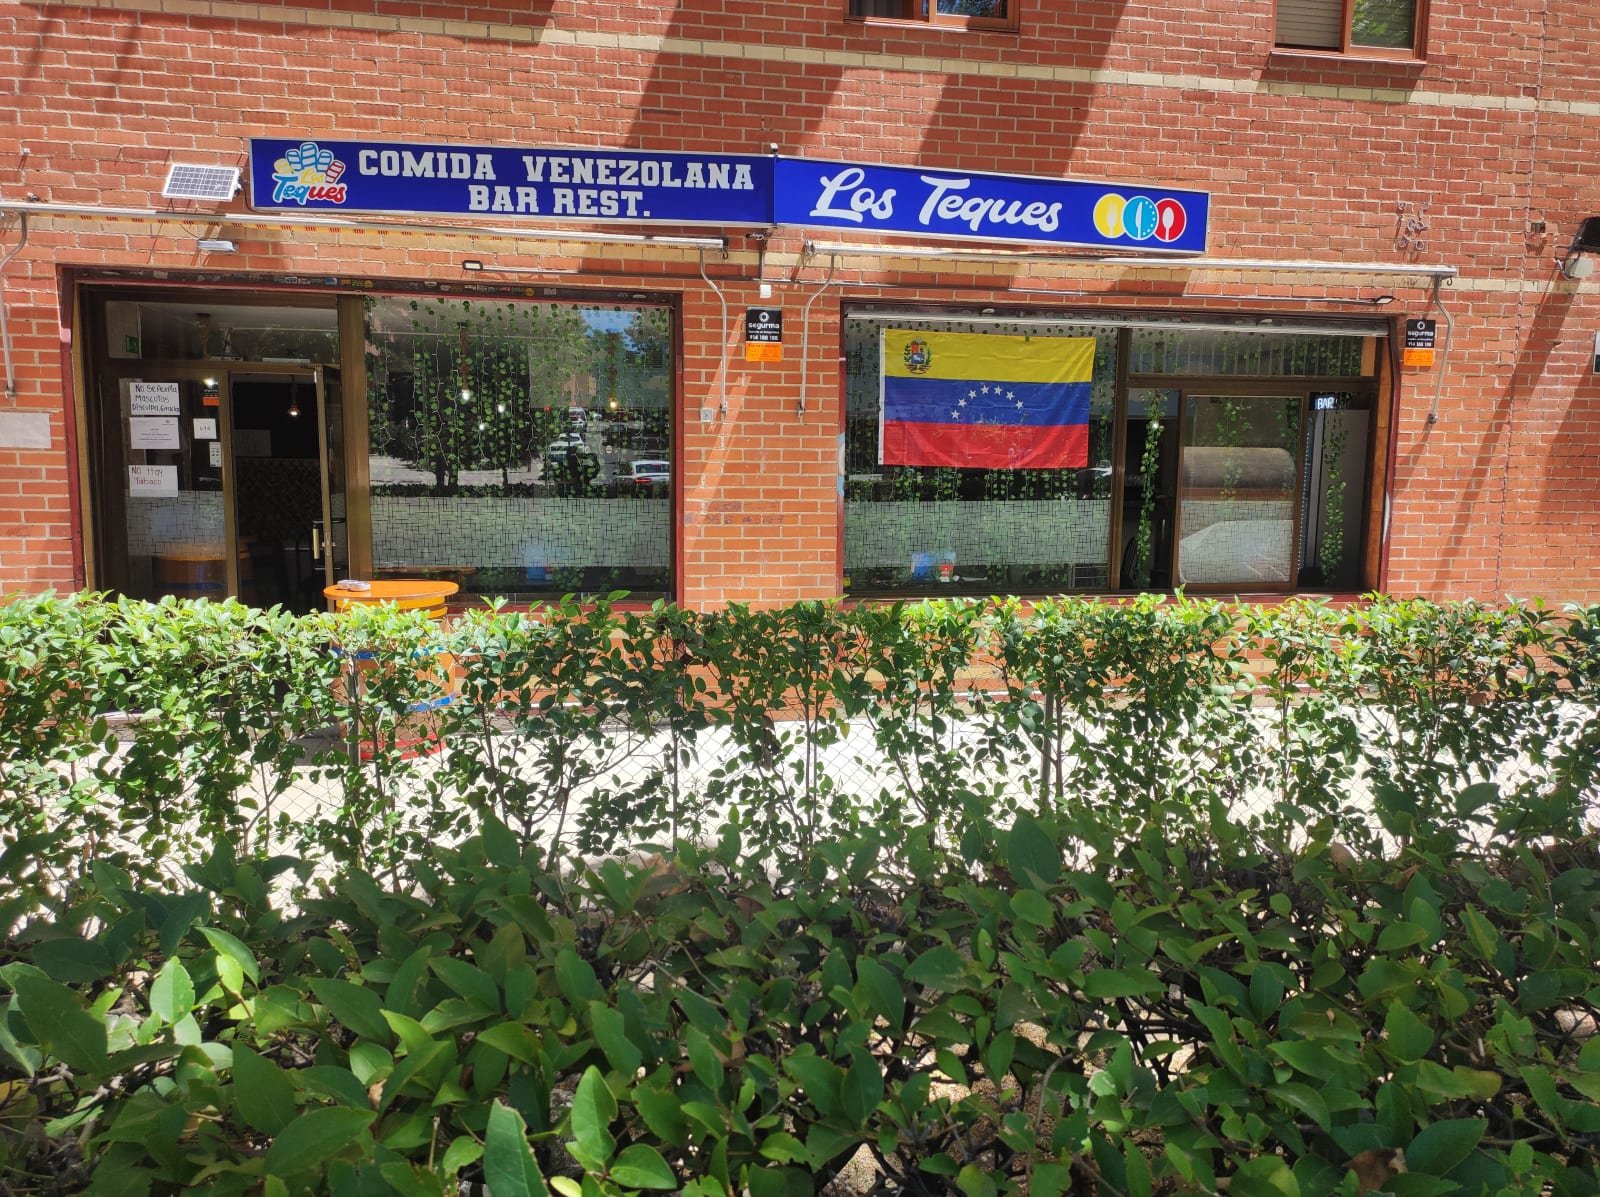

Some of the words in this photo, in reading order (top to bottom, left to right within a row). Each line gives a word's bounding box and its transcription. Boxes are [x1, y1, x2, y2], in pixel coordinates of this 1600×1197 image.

[358, 149, 496, 181] COMIDA
[522, 155, 755, 191] VENEZOLANA
[272, 173, 347, 205] Teques
[469, 185, 540, 212] BAR
[552, 188, 651, 217] REST.
[809, 168, 897, 222] Los
[918, 175, 1062, 232] Teques
[135, 384, 145, 392] No
[1317, 397, 1335, 409] BAR
